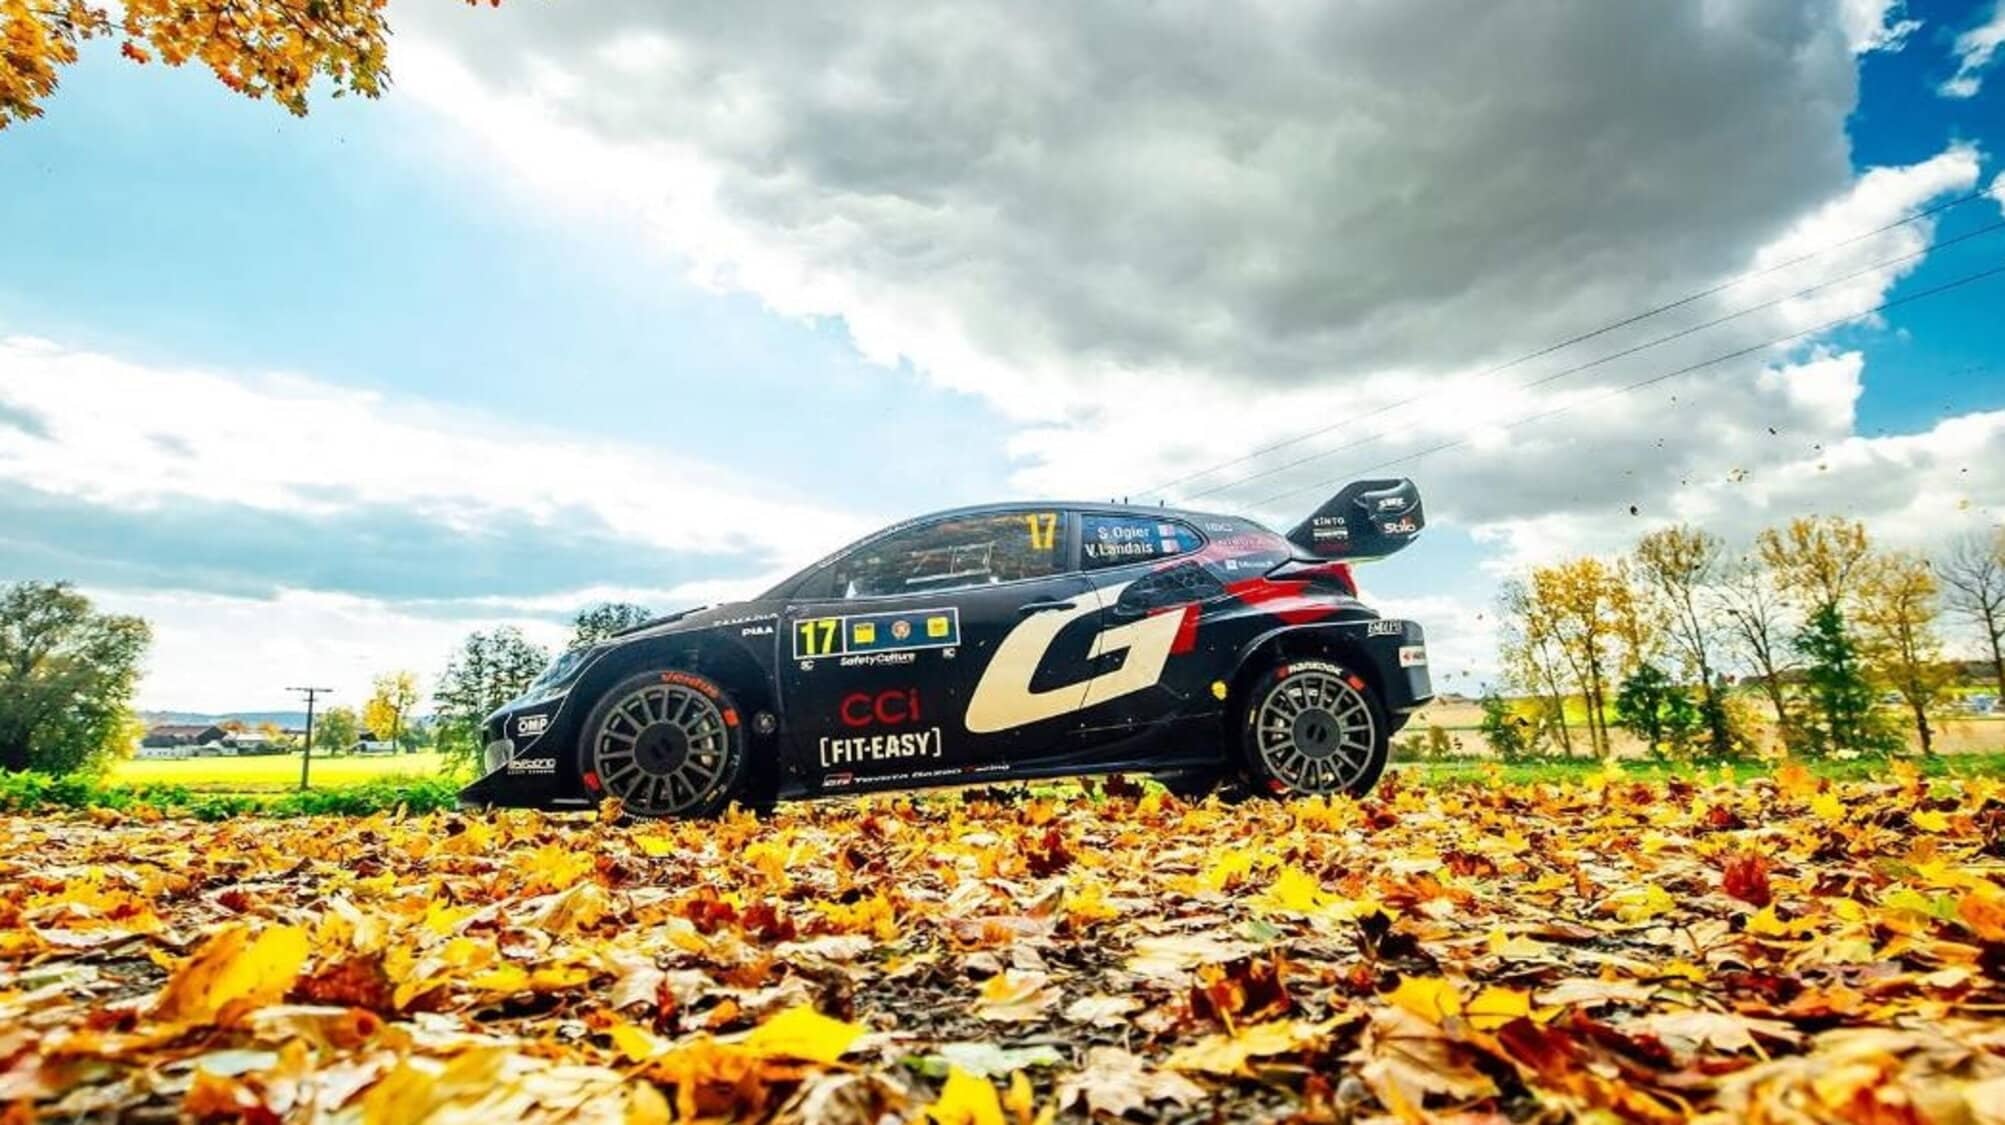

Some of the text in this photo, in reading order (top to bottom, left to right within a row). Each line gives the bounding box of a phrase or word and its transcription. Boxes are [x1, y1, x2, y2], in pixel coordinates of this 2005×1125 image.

[1025, 512, 1058, 550] 17
[742, 626, 774, 636] PIAA
[800, 620, 837, 657] 17
[518, 718, 549, 733] OMP
